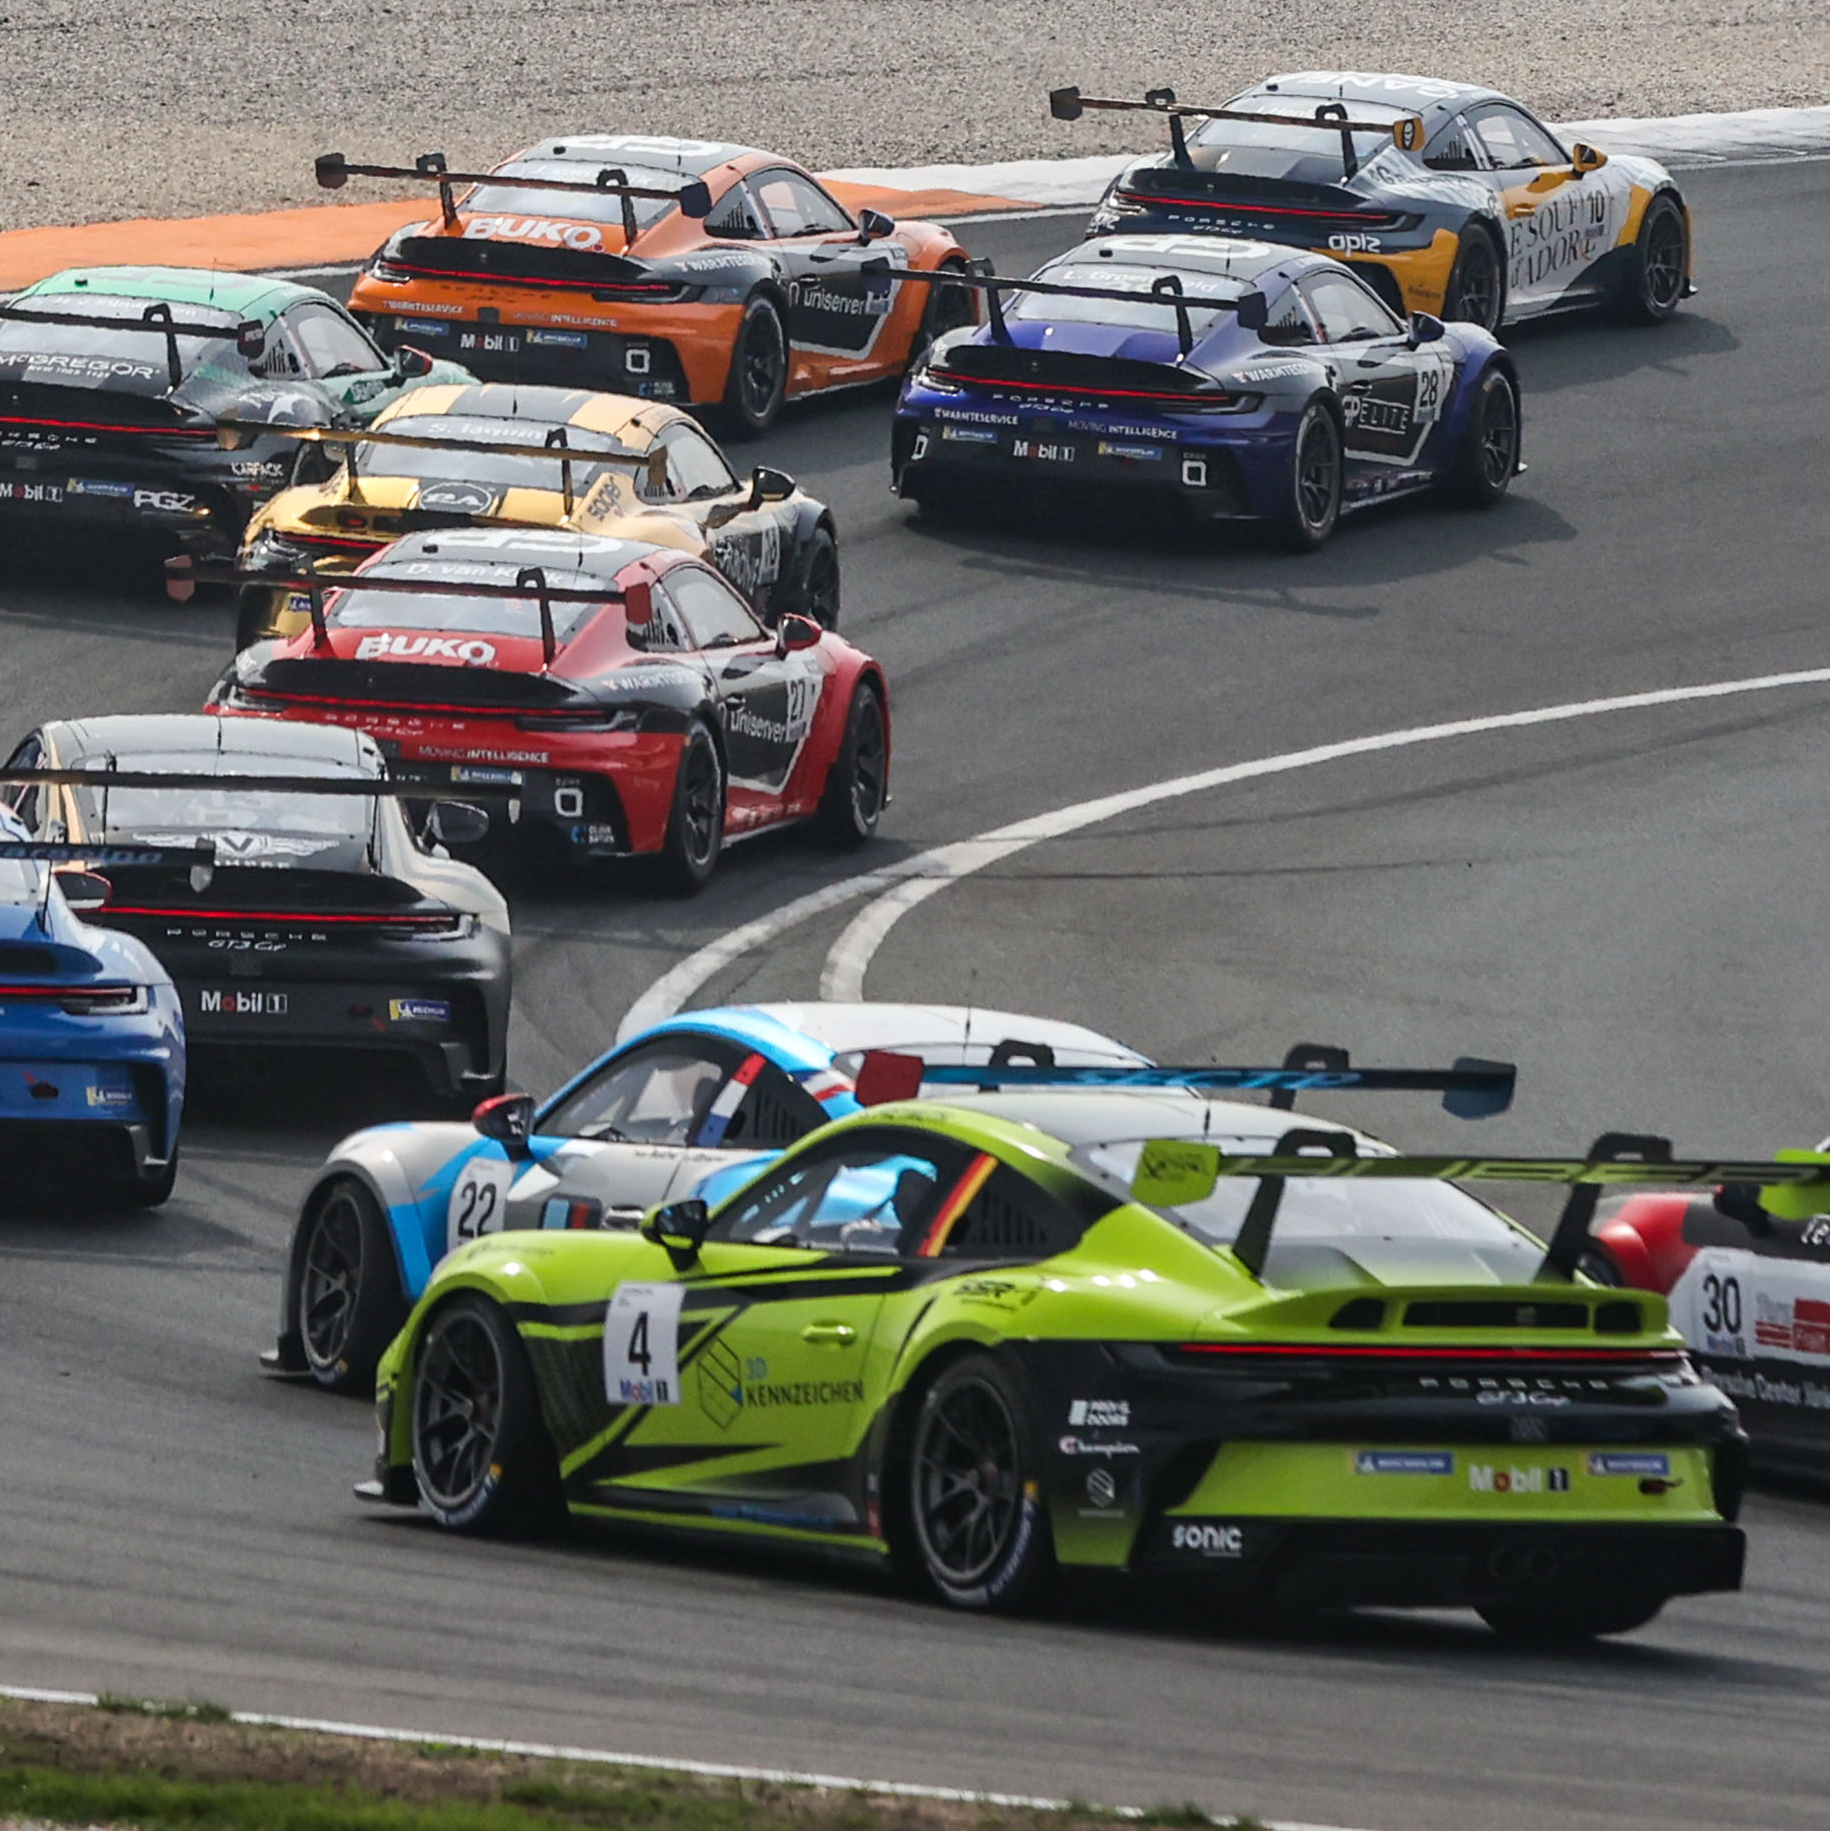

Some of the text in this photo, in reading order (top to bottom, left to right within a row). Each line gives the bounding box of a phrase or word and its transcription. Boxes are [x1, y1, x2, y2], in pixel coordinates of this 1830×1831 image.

[1586, 190, 1606, 225] 10
[463, 217, 602, 250] BUKO
[803, 289, 866, 316] uniserver
[459, 333, 504, 351] Mobil
[1419, 369, 1439, 407] 28
[1107, 424, 1178, 440] INTELLIGENCE
[1013, 440, 1058, 461] Mobil
[132, 489, 195, 512] PGZ
[355, 633, 496, 665] BUKO
[789, 679, 807, 722] 27
[729, 709, 787, 744] uniserver
[466, 748, 550, 764] INTELLIGENCE
[166, 928, 328, 942] PORSCHE
[201, 990, 263, 1014] Mobil
[458, 1180, 497, 1239] 22
[1702, 1273, 1743, 1335] 30
[627, 1311, 652, 1376] 4
[744, 1357, 768, 1381] 3D
[747, 1380, 866, 1408] KENNZEICHEN
[1058, 1434, 1141, 1459] Champion
[1469, 1465, 1544, 1494] Mobil
